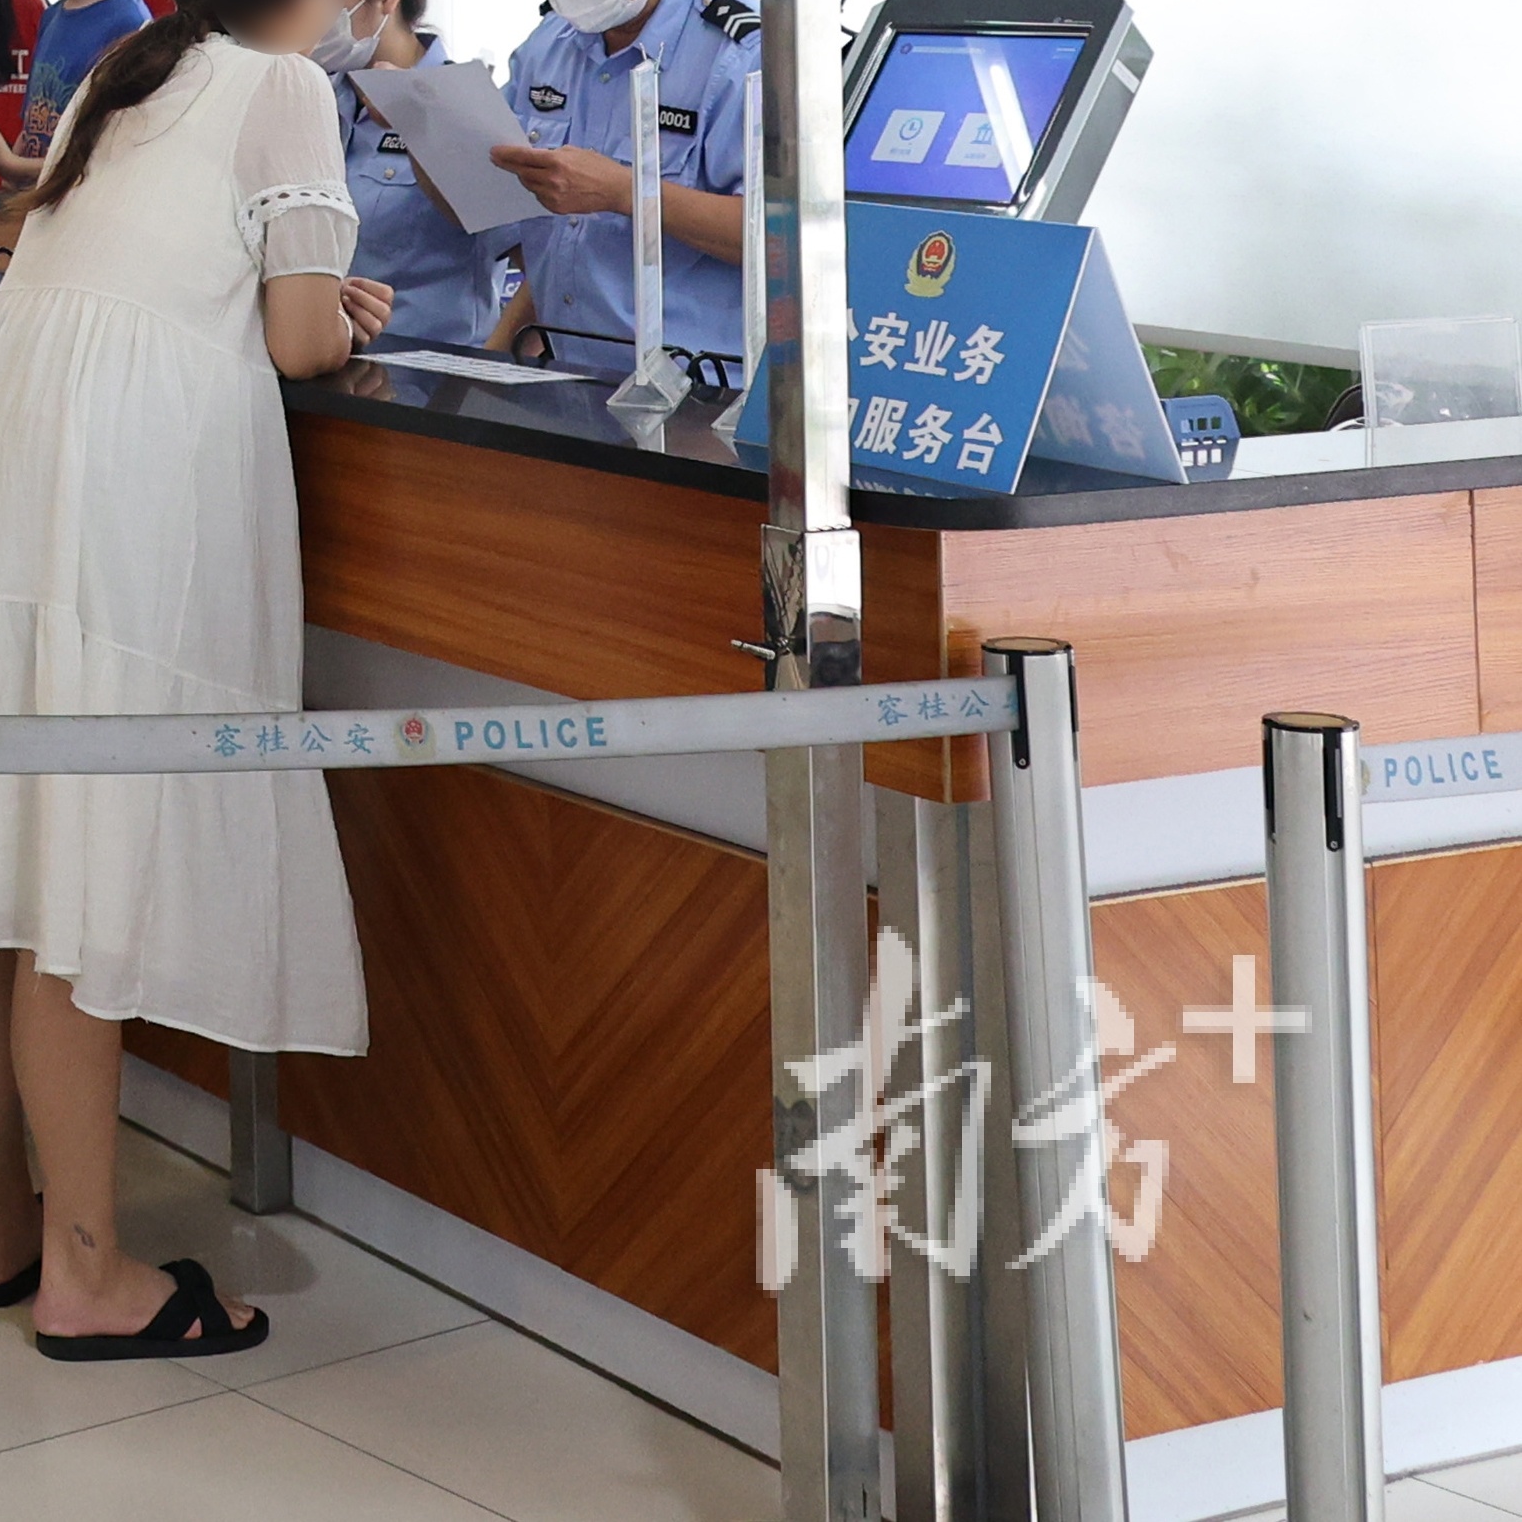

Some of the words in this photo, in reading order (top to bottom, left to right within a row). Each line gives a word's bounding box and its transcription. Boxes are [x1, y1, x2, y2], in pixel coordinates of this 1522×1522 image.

[213, 722, 376, 758] 容桂公安
[456, 716, 608, 752] POLICE
[1384, 749, 1504, 789] POLICE
